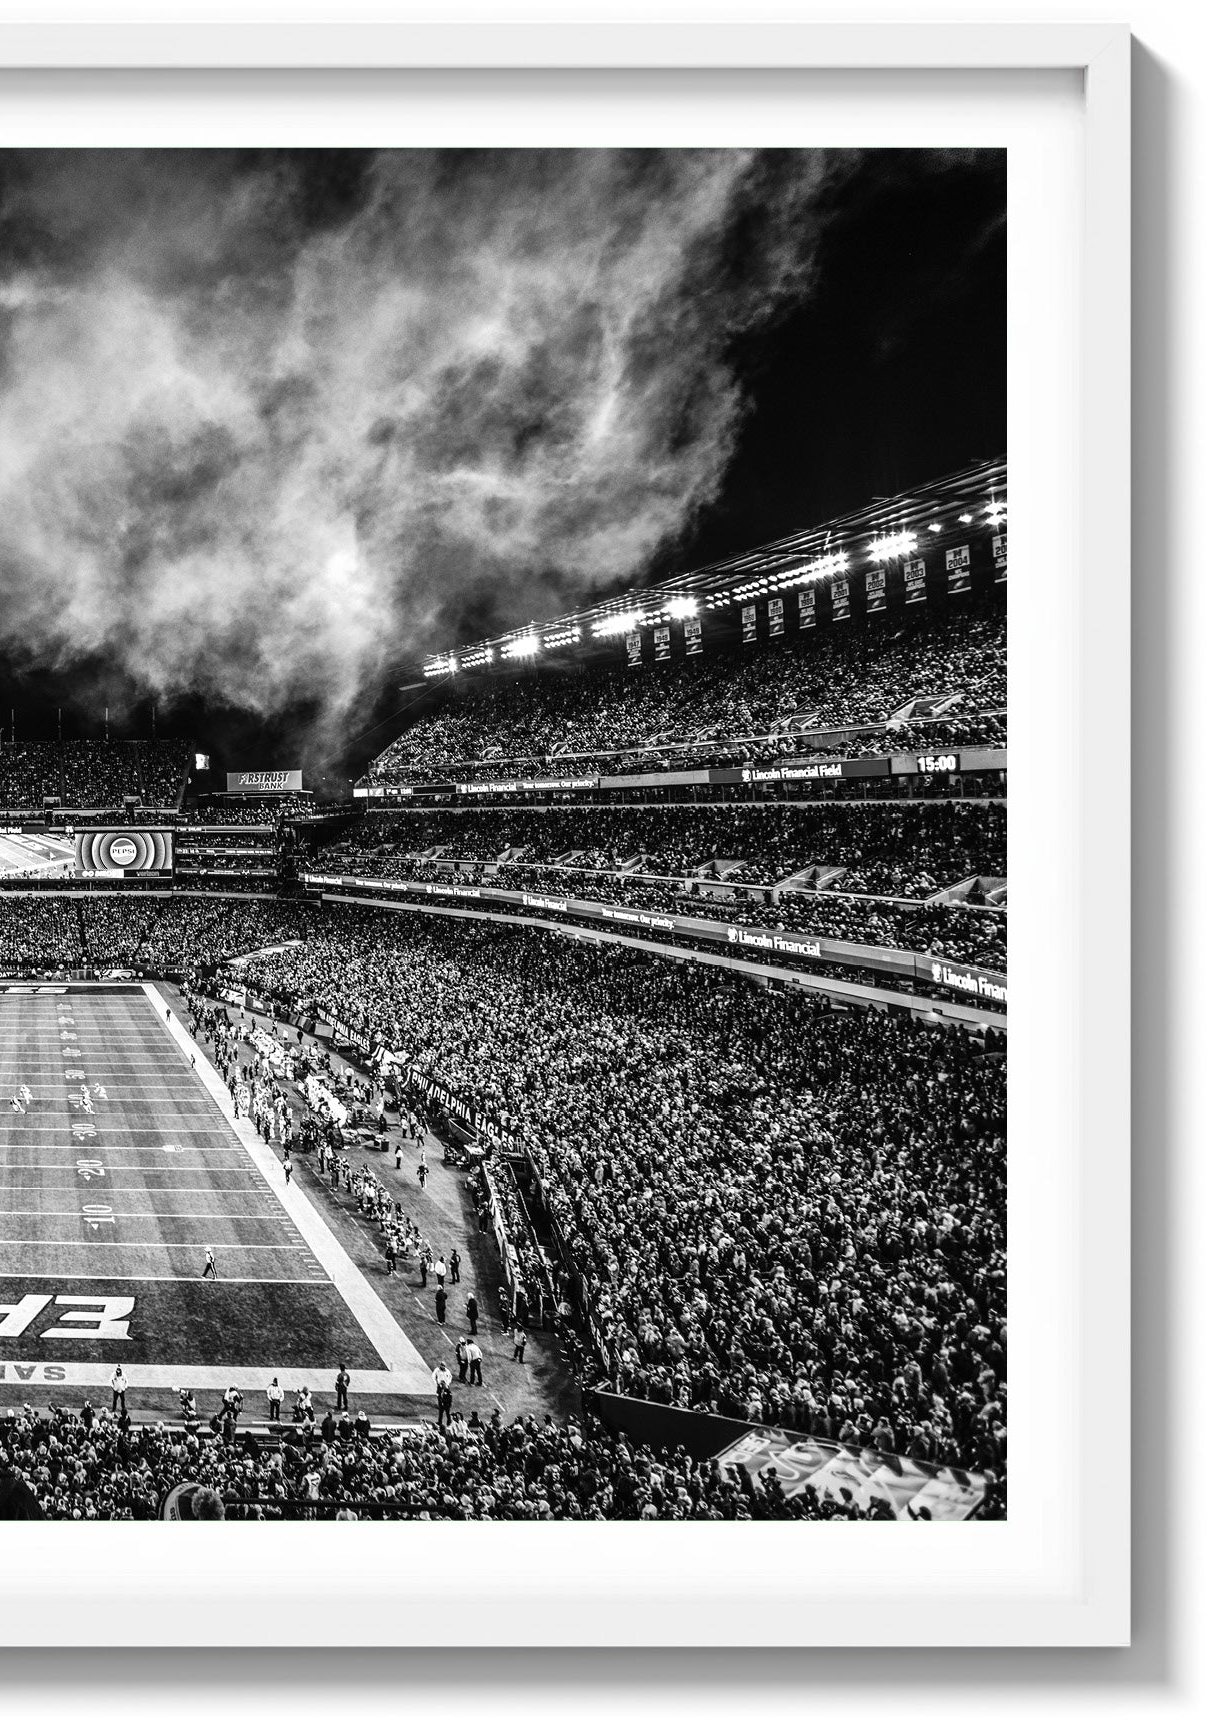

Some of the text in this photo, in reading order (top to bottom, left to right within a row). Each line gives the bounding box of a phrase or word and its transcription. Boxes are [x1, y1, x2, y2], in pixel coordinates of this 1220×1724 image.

[948, 556, 968, 569] 2004
[906, 568, 924, 580] 2003
[867, 578, 884, 590] 2002
[686, 627, 700, 636] 1949
[628, 640, 639, 649] 1947
[918, 755, 956, 771] 15:00
[752, 764, 842, 781] Lincoln Financial Field
[259, 782, 283, 790] BANK
[468, 783, 517, 793] Lincoln Financial
[8, 826, 22, 834] Field
[433, 886, 480, 898] Lincoln Financial
[738, 930, 821, 957] Lincoln Financial
[943, 967, 978, 992] Lincoln
[350, 1029, 370, 1051] EAGLES
[71, 1123, 97, 1137] 30
[76, 1159, 106, 1176] 20
[82, 1204, 116, 1223] 10
